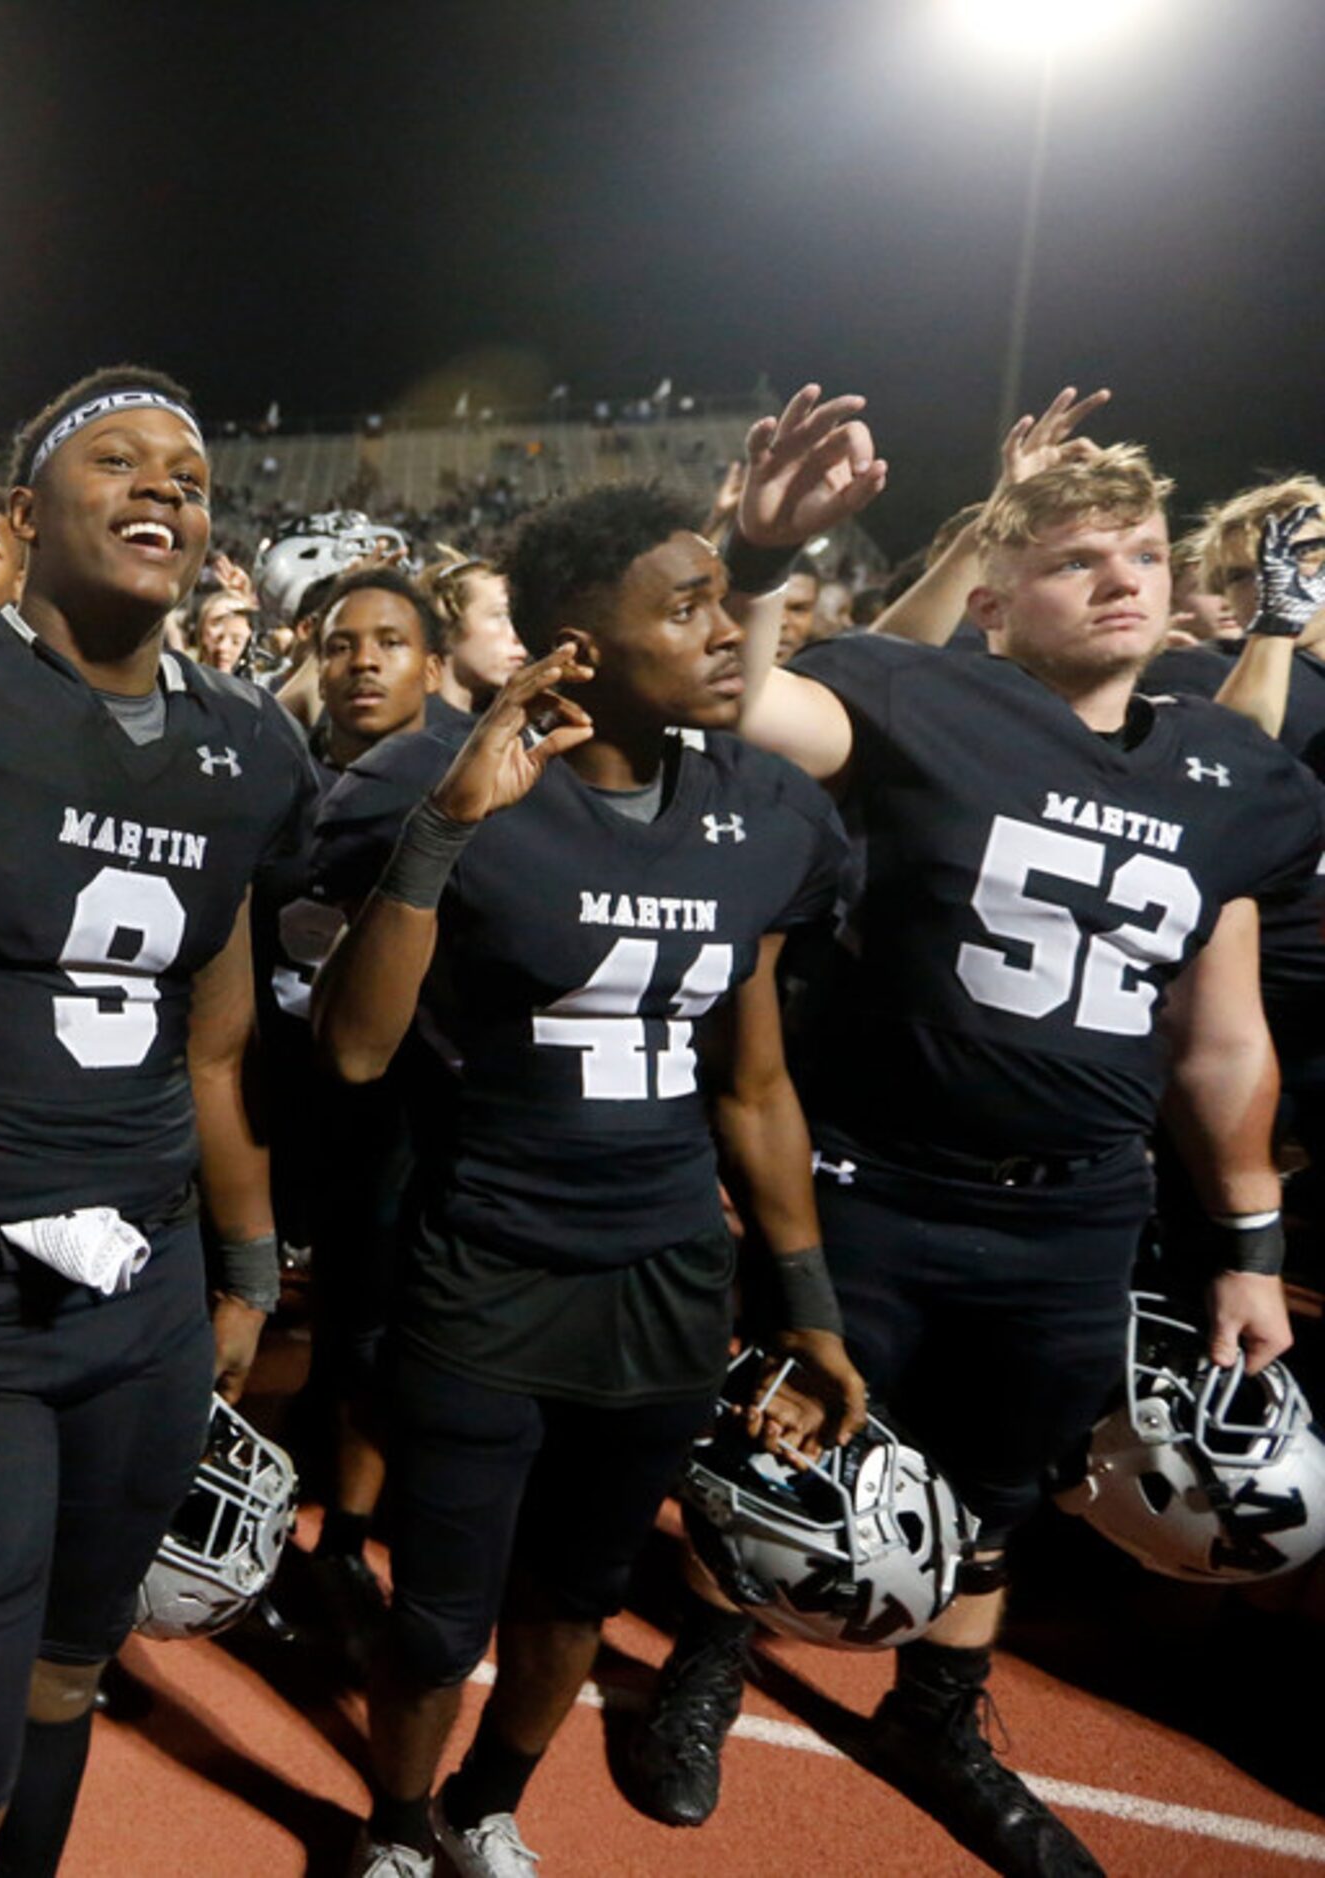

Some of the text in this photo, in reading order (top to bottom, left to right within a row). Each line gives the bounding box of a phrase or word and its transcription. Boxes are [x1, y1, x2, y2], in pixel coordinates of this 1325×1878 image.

[58, 806, 208, 870] MARTIN
[1042, 791, 1184, 852] MARTIN
[579, 891, 718, 932] MARTIN
[955, 814, 1202, 1036] 52
[532, 937, 734, 1100] 41
